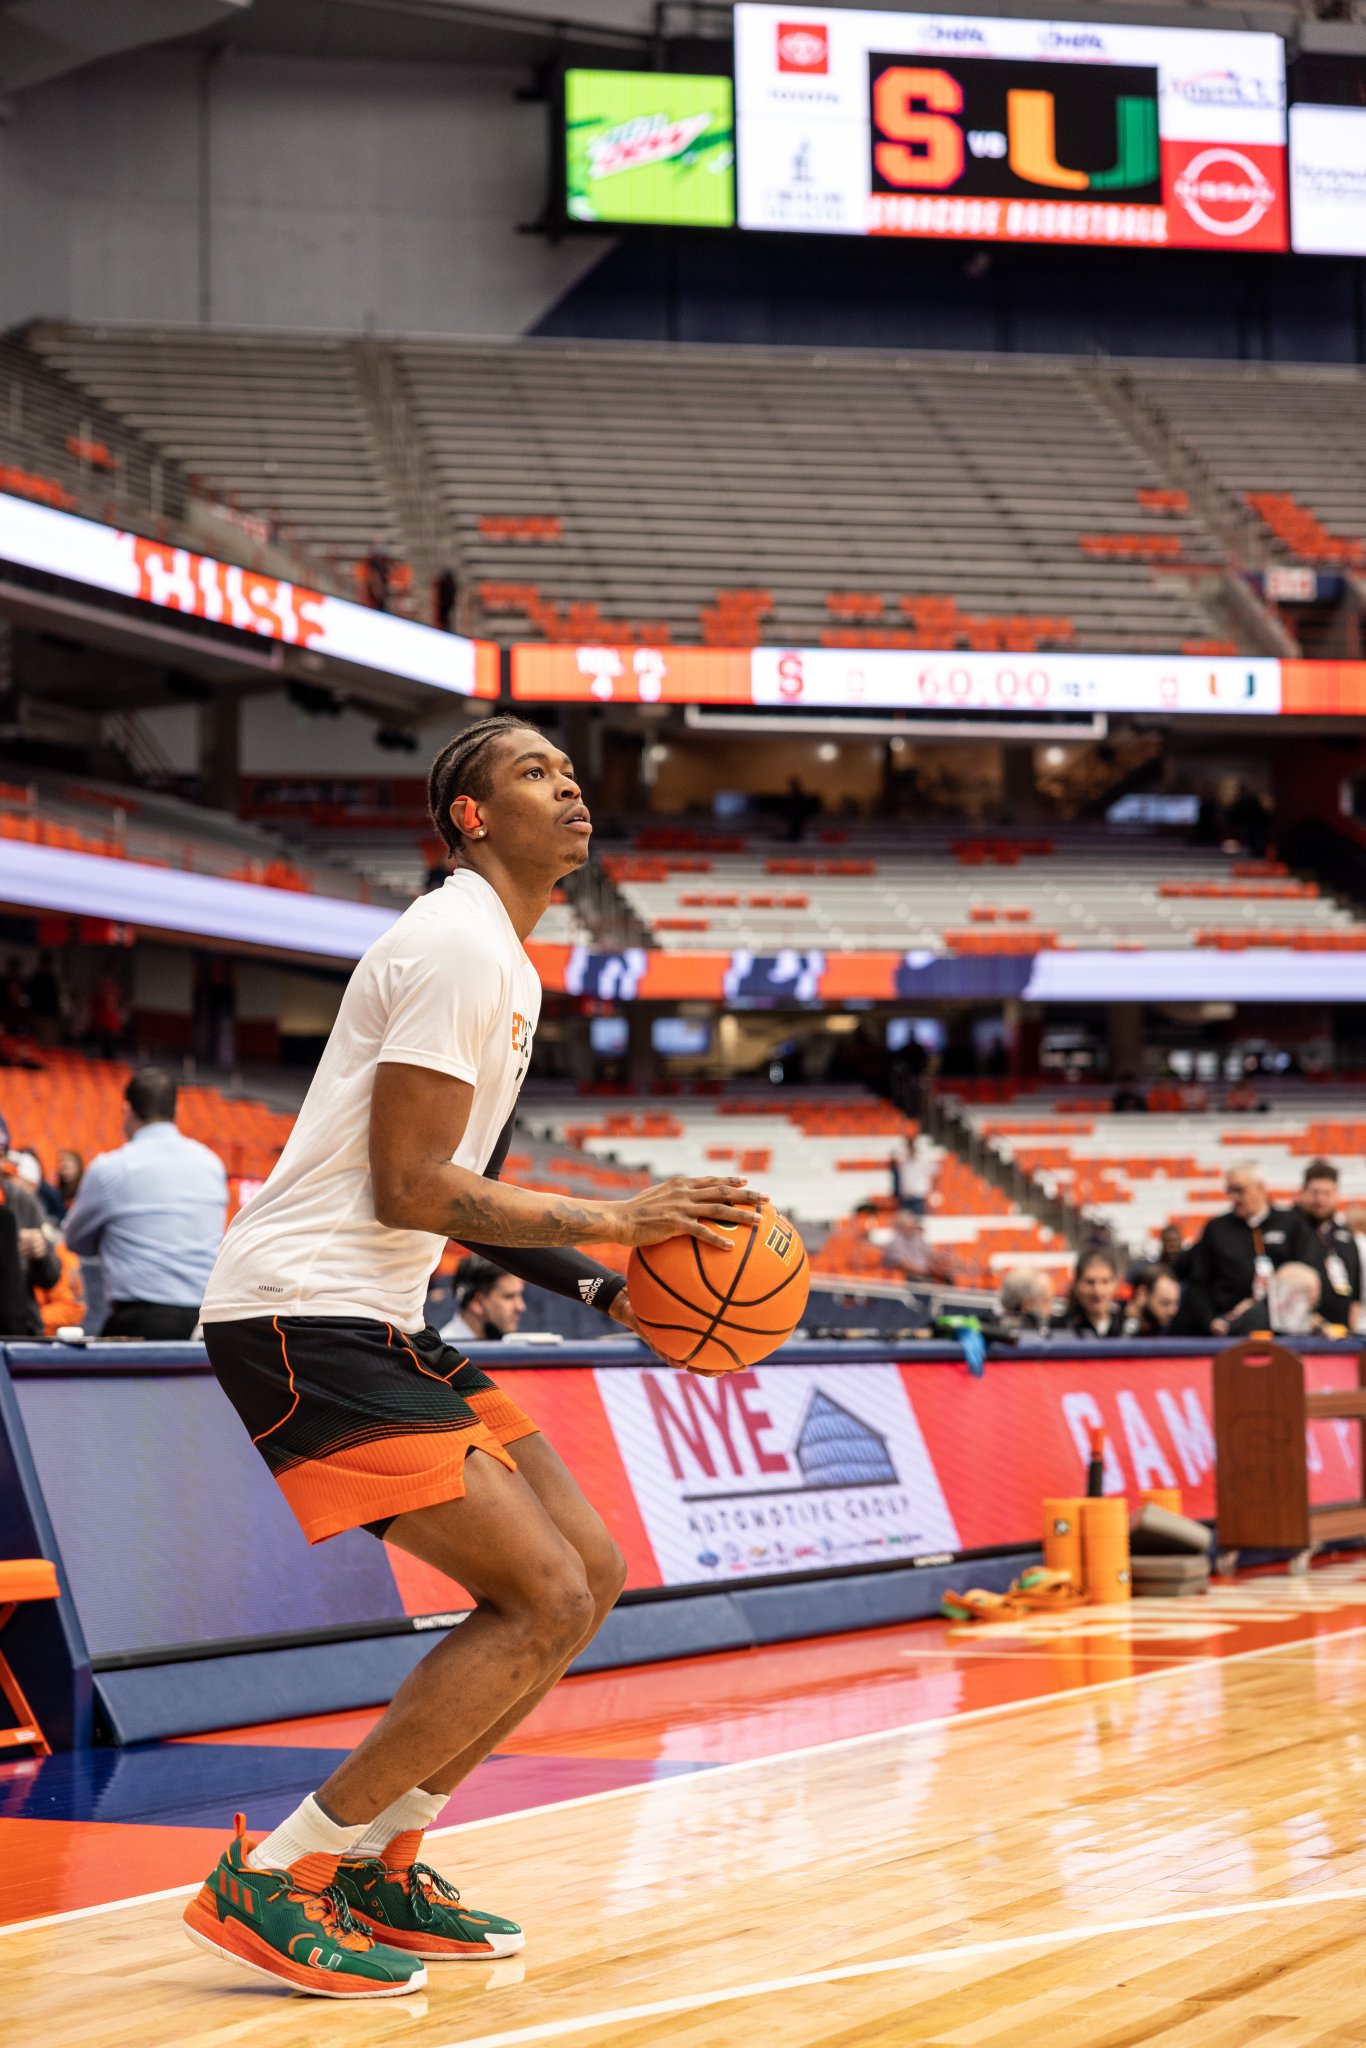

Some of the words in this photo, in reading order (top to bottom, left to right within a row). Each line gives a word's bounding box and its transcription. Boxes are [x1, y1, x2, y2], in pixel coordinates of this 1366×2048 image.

[873, 66, 965, 189] S
[1007, 88, 1161, 190] U
[586, 1277, 604, 1305] adidas
[641, 1371, 790, 1481] NYE
[1061, 1387, 1217, 1496] GAM
[307, 1946, 342, 1972] U
